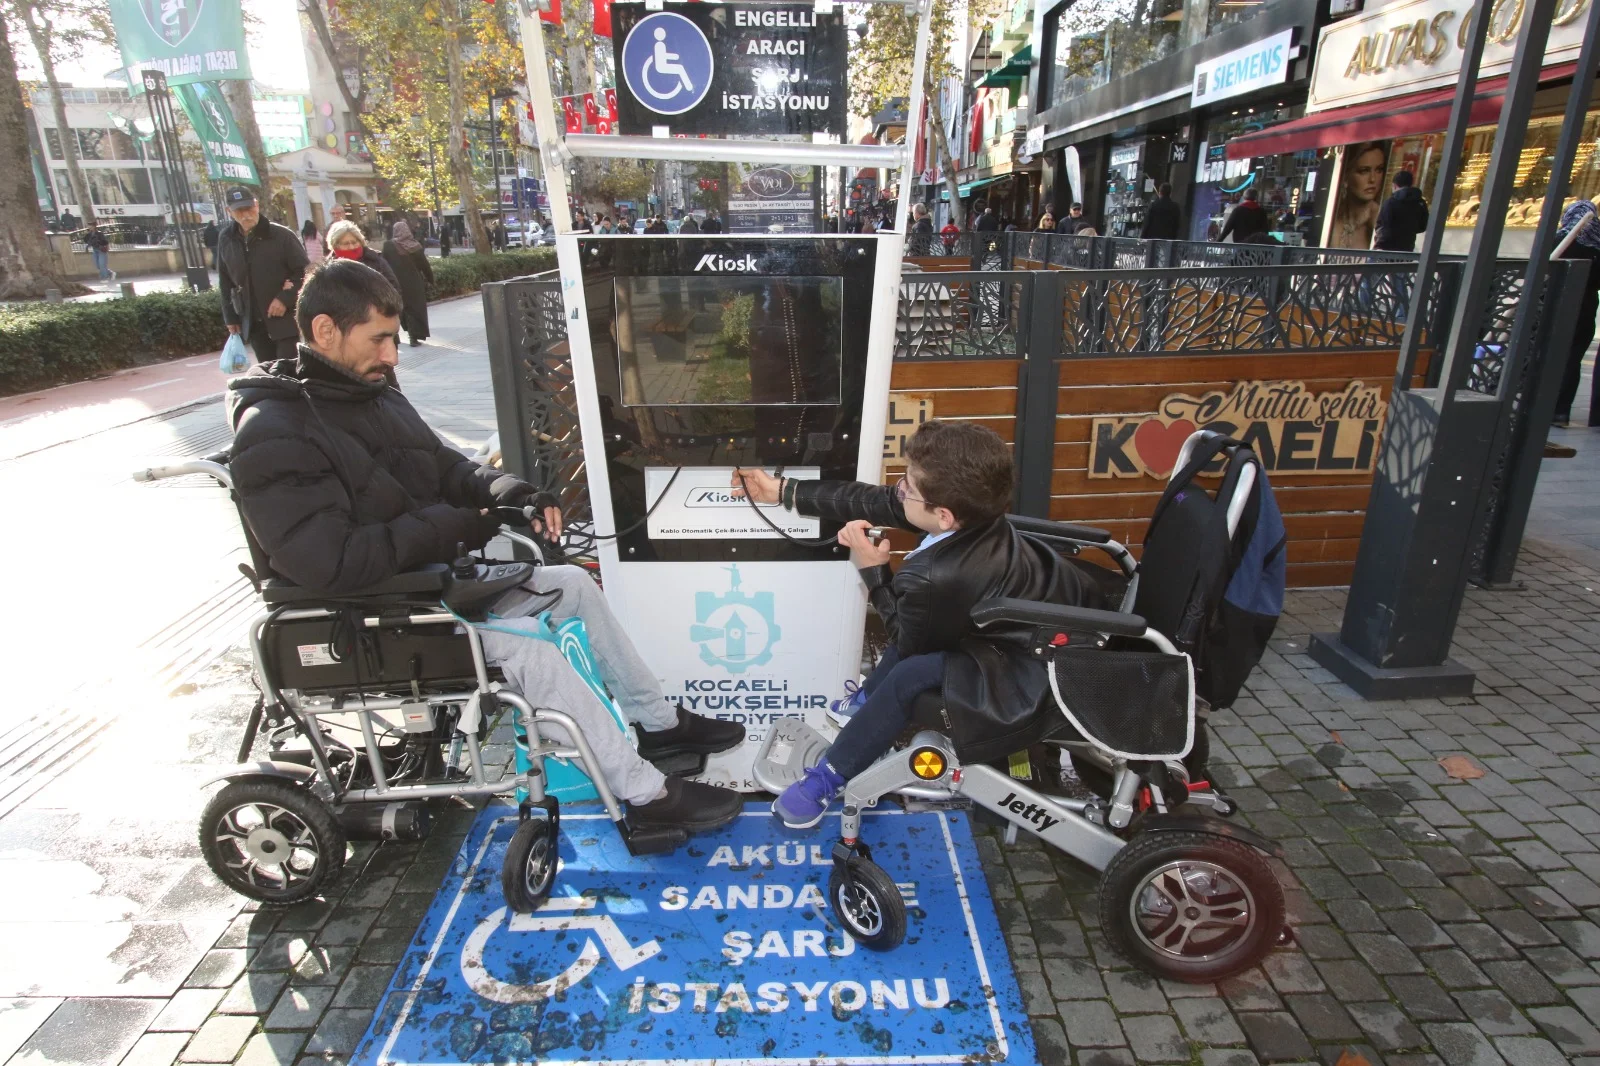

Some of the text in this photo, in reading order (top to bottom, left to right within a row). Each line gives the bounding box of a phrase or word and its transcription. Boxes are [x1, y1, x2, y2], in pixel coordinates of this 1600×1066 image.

[746, 40, 805, 55] ARACI
[1212, 45, 1282, 92] SIEMENS
[722, 91, 830, 110] İSTASYONU
[694, 254, 758, 271] Kiosk
[1310, 384, 1381, 426] şehir
[998, 792, 1060, 832] Jetty
[706, 840, 834, 866] AKÜL
[659, 882, 920, 910] SANDAE
[721, 930, 856, 966] ŞARJ
[627, 976, 950, 1014] İSTASYONU
